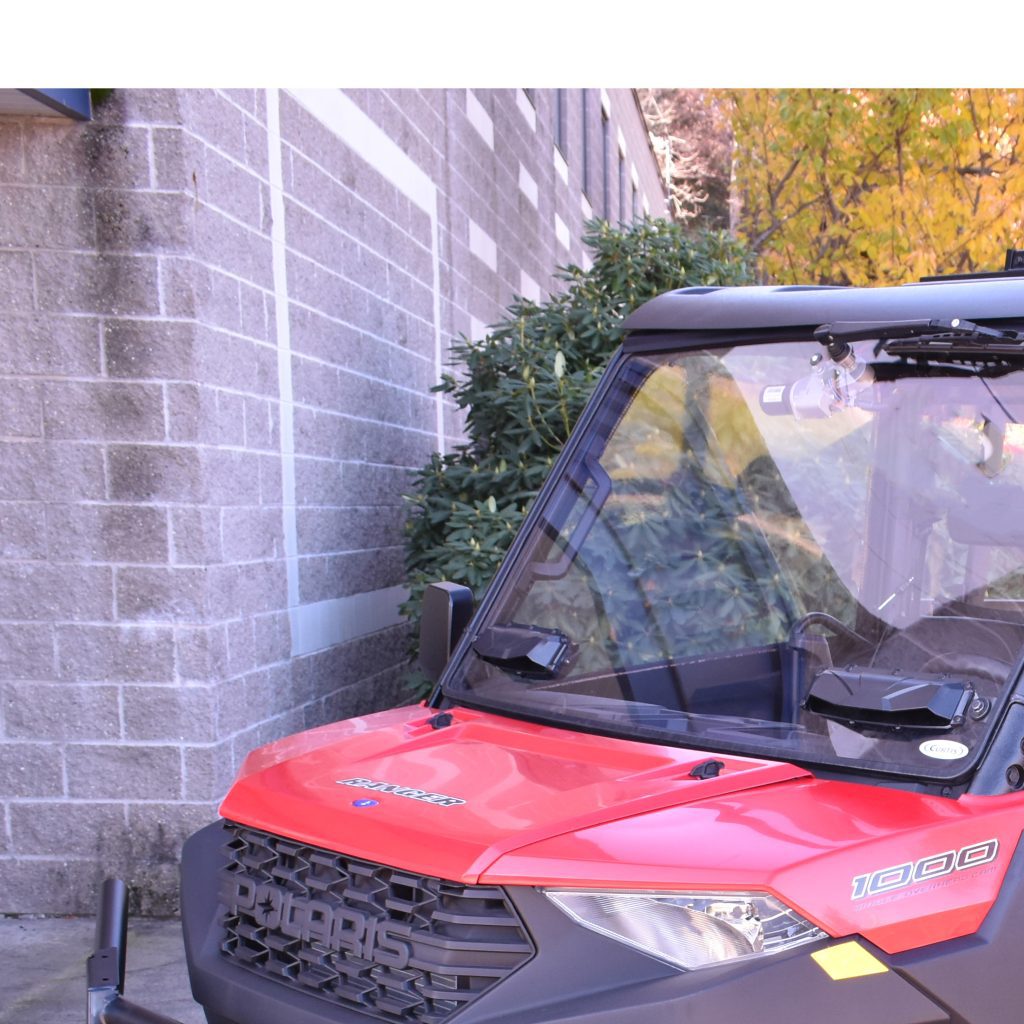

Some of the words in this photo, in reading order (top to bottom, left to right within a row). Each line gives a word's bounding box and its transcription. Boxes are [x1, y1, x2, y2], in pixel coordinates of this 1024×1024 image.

[335, 777, 467, 807] RANGER
[850, 838, 999, 900] 1000
[233, 881, 413, 970] POLARIS
